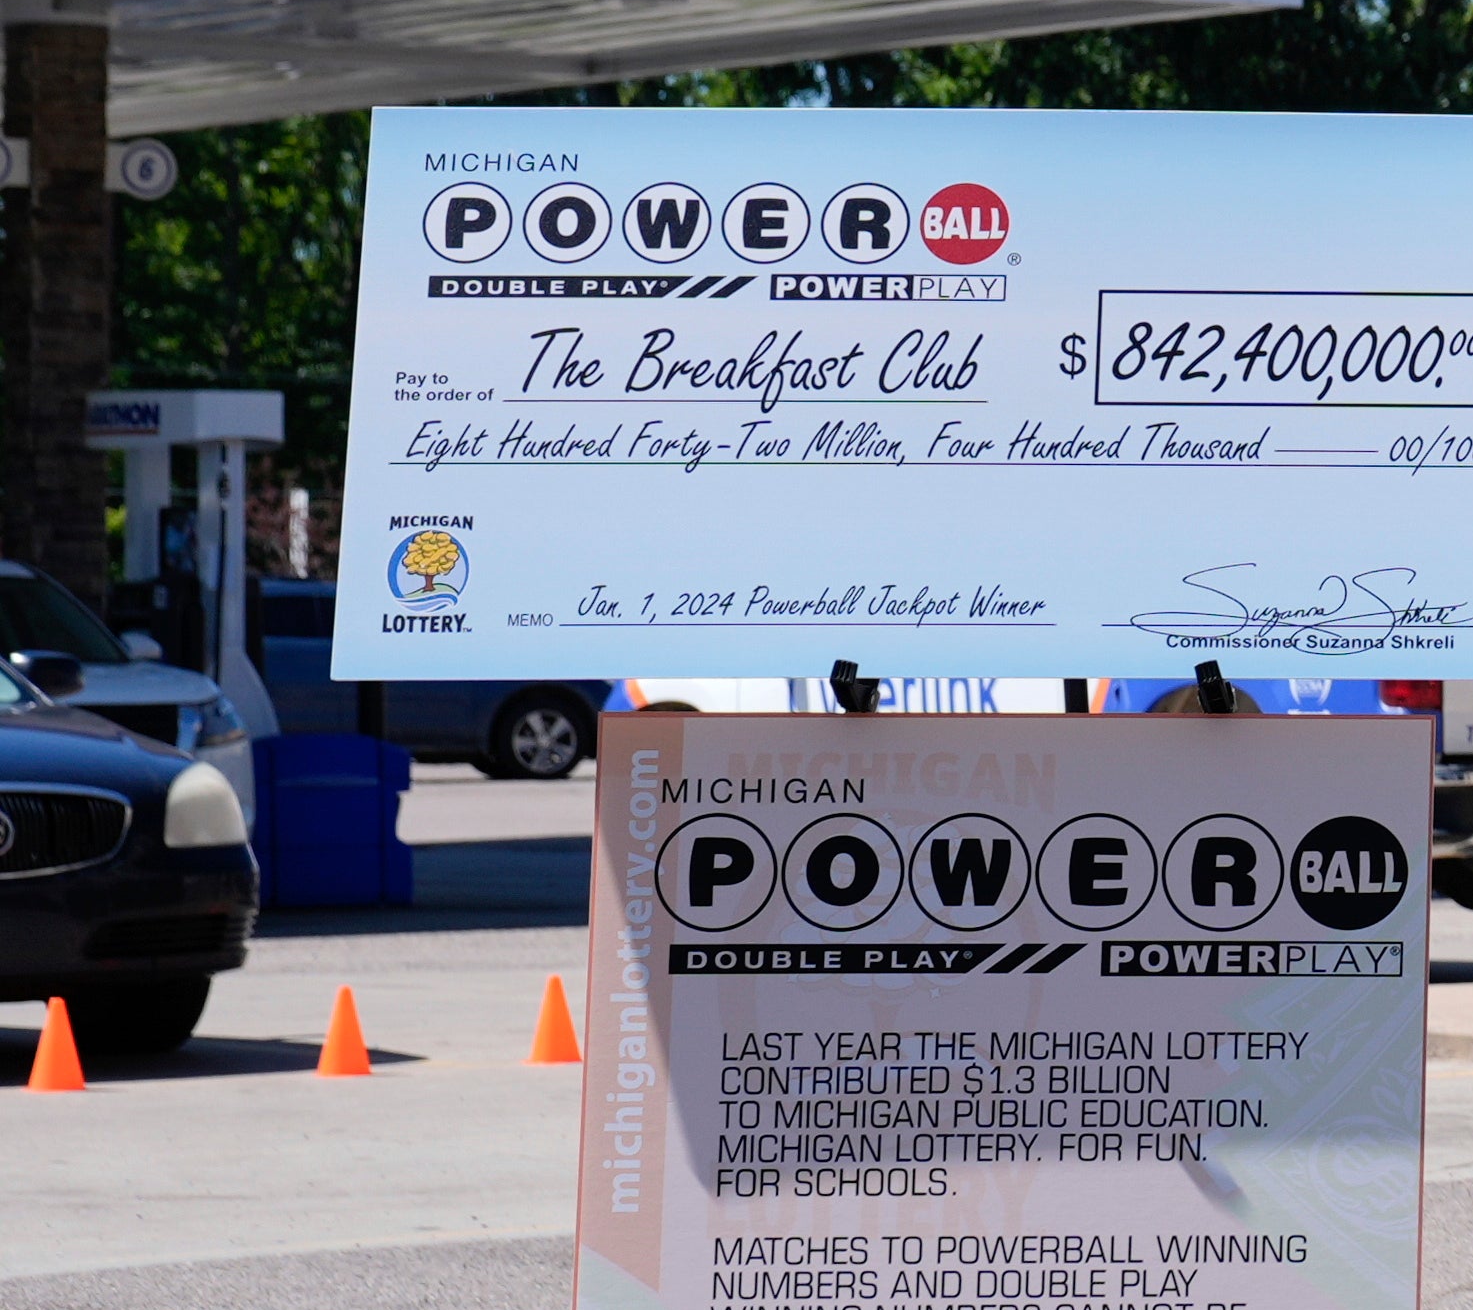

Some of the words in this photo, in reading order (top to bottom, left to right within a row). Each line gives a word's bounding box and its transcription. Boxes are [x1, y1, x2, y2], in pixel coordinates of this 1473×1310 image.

[425, 152, 578, 172] MICHIGAN
[441, 278, 566, 296] DOUBLE
[1059, 332, 1087, 380] $
[395, 371, 427, 388] Pay
[432, 372, 449, 385] to
[521, 327, 605, 393] The
[624, 327, 862, 413] Breakfast
[878, 328, 984, 394] Club
[394, 388, 421, 401] the
[426, 388, 472, 402] order
[476, 388, 495, 402] of
[404, 420, 489, 473] Eight
[496, 418, 621, 461] Hundred
[626, 420, 793, 473] Forty-Two
[802, 420, 905, 467] Million,
[927, 420, 995, 459] Four
[1007, 419, 1124, 461] Hundred
[1140, 421, 1270, 463] Thousand
[389, 515, 474, 531] MICHIGAN
[507, 613, 554, 627] MEMO
[577, 584, 622, 618] Jan.
[640, 592, 657, 624] 1,
[670, 591, 736, 616] 2024
[744, 585, 866, 617] Powerball
[867, 583, 962, 629] Jackpot
[969, 584, 1046, 618] Winner
[1166, 633, 1299, 649] Commissioner
[1306, 633, 1385, 649] Suzanna
[1391, 632, 1455, 648] Shkreli
[661, 778, 865, 804] MICHIGAN
[605, 746, 662, 1216] michiganlottery.com
[722, 1032, 804, 1062] LAST
[814, 1032, 901, 1061] YEAR
[913, 1031, 977, 1061] THE
[997, 1031, 1153, 1061] MICHIGAN
[1166, 1031, 1309, 1060] LOTTERY
